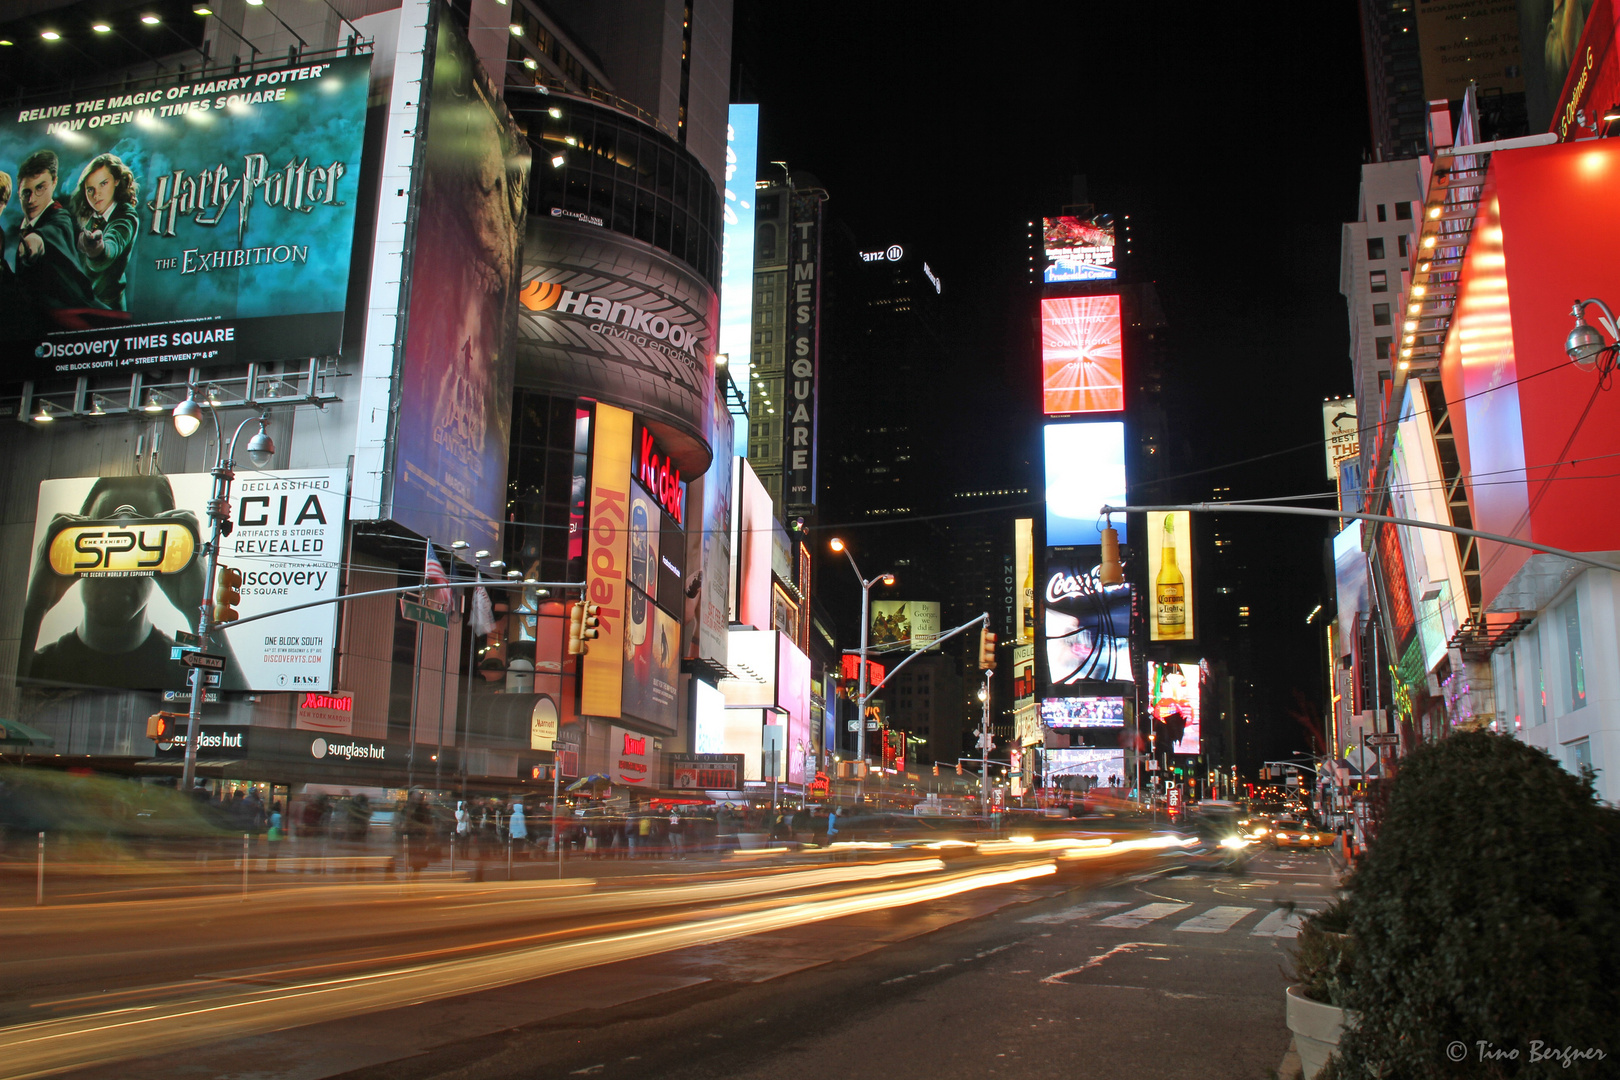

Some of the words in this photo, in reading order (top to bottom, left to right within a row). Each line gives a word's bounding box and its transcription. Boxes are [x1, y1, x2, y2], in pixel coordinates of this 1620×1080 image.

[18, 104, 72, 123] RELIVE
[75, 100, 105, 115] THE
[107, 90, 163, 110] MAGIC
[166, 85, 189, 101] OF
[192, 76, 252, 96] HARRY
[1566, 66, 1588, 124] Optimus
[46, 118, 86, 135] NOW
[88, 111, 133, 129] OPEN
[135, 107, 155, 121] IN
[159, 99, 210, 119] TIMES
[215, 88, 287, 110] SQUARE
[147, 163, 239, 237] Harry
[238, 153, 347, 246] Potter
[156, 257, 177, 270] THE
[794, 222, 814, 324] TIMES
[1051, 316, 1107, 326] INDUSTRIAL
[42, 338, 120, 358] Discovery
[124, 334, 168, 351] TIMES
[172, 328, 235, 345] SQUARE
[590, 322, 647, 348] driving
[650, 341, 697, 370] emotion
[1050, 338, 1112, 348] COMMERCIAL
[55, 364, 69, 372] ONE
[70, 362, 91, 371] BLOCK
[91, 360, 113, 369] SOUTH
[135, 356, 159, 364] STREET
[159, 353, 191, 362] BETWEEN
[1067, 361, 1096, 369] CHINA
[792, 337, 813, 470] SQUARE
[1331, 433, 1355, 444] BEST
[641, 427, 683, 524] Kodak
[242, 480, 330, 492] DECLASSIFIED
[237, 494, 328, 526] CIA
[237, 529, 280, 537] ARTIFACTS
[290, 528, 325, 536] STORIES
[74, 530, 168, 568] SPY
[235, 539, 324, 553] REVEALED
[590, 486, 626, 635] Kodak
[253, 587, 289, 595] SQUARE
[922, 604, 929, 612] By
[1004, 565, 1012, 635] NOVOTEL
[914, 611, 938, 619] George,
[264, 637, 277, 646] ONE
[279, 637, 300, 646] BLOCK
[302, 637, 323, 646] SOUTH
[263, 654, 322, 663] DISCOVERYTS.COM
[293, 676, 320, 684] BASE
[301, 692, 352, 712] Marriott
[300, 710, 311, 718] NEW
[312, 711, 326, 719] YORK
[327, 713, 351, 723] MARQUIS
[535, 719, 554, 728] Marriott
[174, 731, 221, 750] suglass
[222, 731, 243, 748] hut
[328, 742, 369, 760] sunglass
[369, 744, 385, 760] hut
[674, 754, 739, 762] MARQUIS
[699, 770, 734, 787] EVITA
[1169, 789, 1178, 806] tkts
